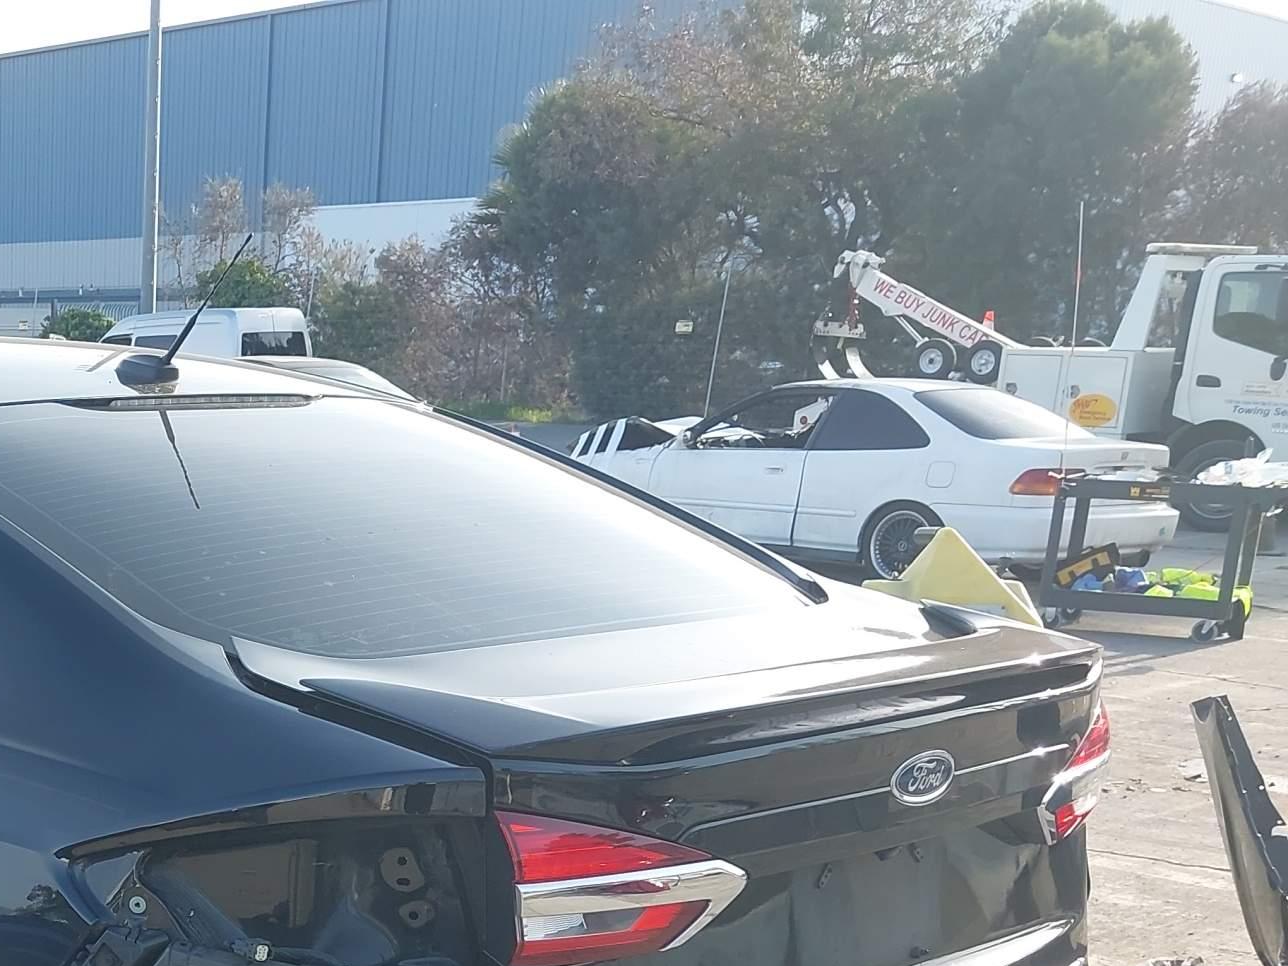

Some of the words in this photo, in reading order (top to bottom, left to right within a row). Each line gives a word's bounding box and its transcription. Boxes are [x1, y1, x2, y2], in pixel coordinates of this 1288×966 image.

[873, 278, 898, 300] WE
[894, 289, 925, 314] BUY
[922, 306, 960, 334] JUNK
[1232, 405, 1271, 418] Towing
[908, 760, 945, 792] Ford
